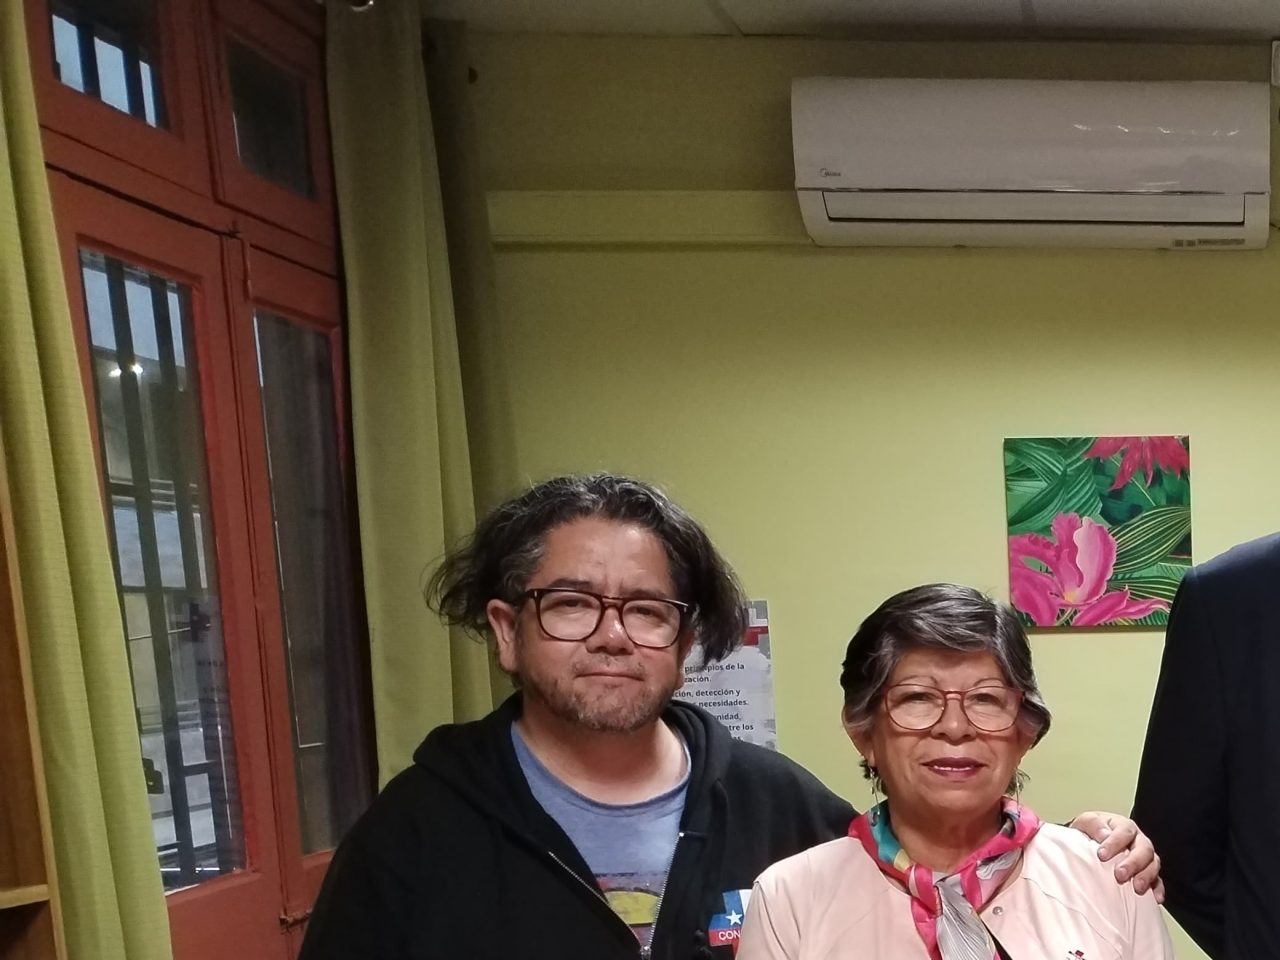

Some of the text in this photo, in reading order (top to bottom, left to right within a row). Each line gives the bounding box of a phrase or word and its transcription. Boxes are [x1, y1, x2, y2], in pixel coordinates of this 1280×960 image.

[725, 663, 735, 671] de
[737, 662, 745, 670] la
[695, 688, 734, 697] detección
[735, 689, 741, 697] y
[698, 699, 750, 708] necesidades.
[742, 723, 754, 731] los
